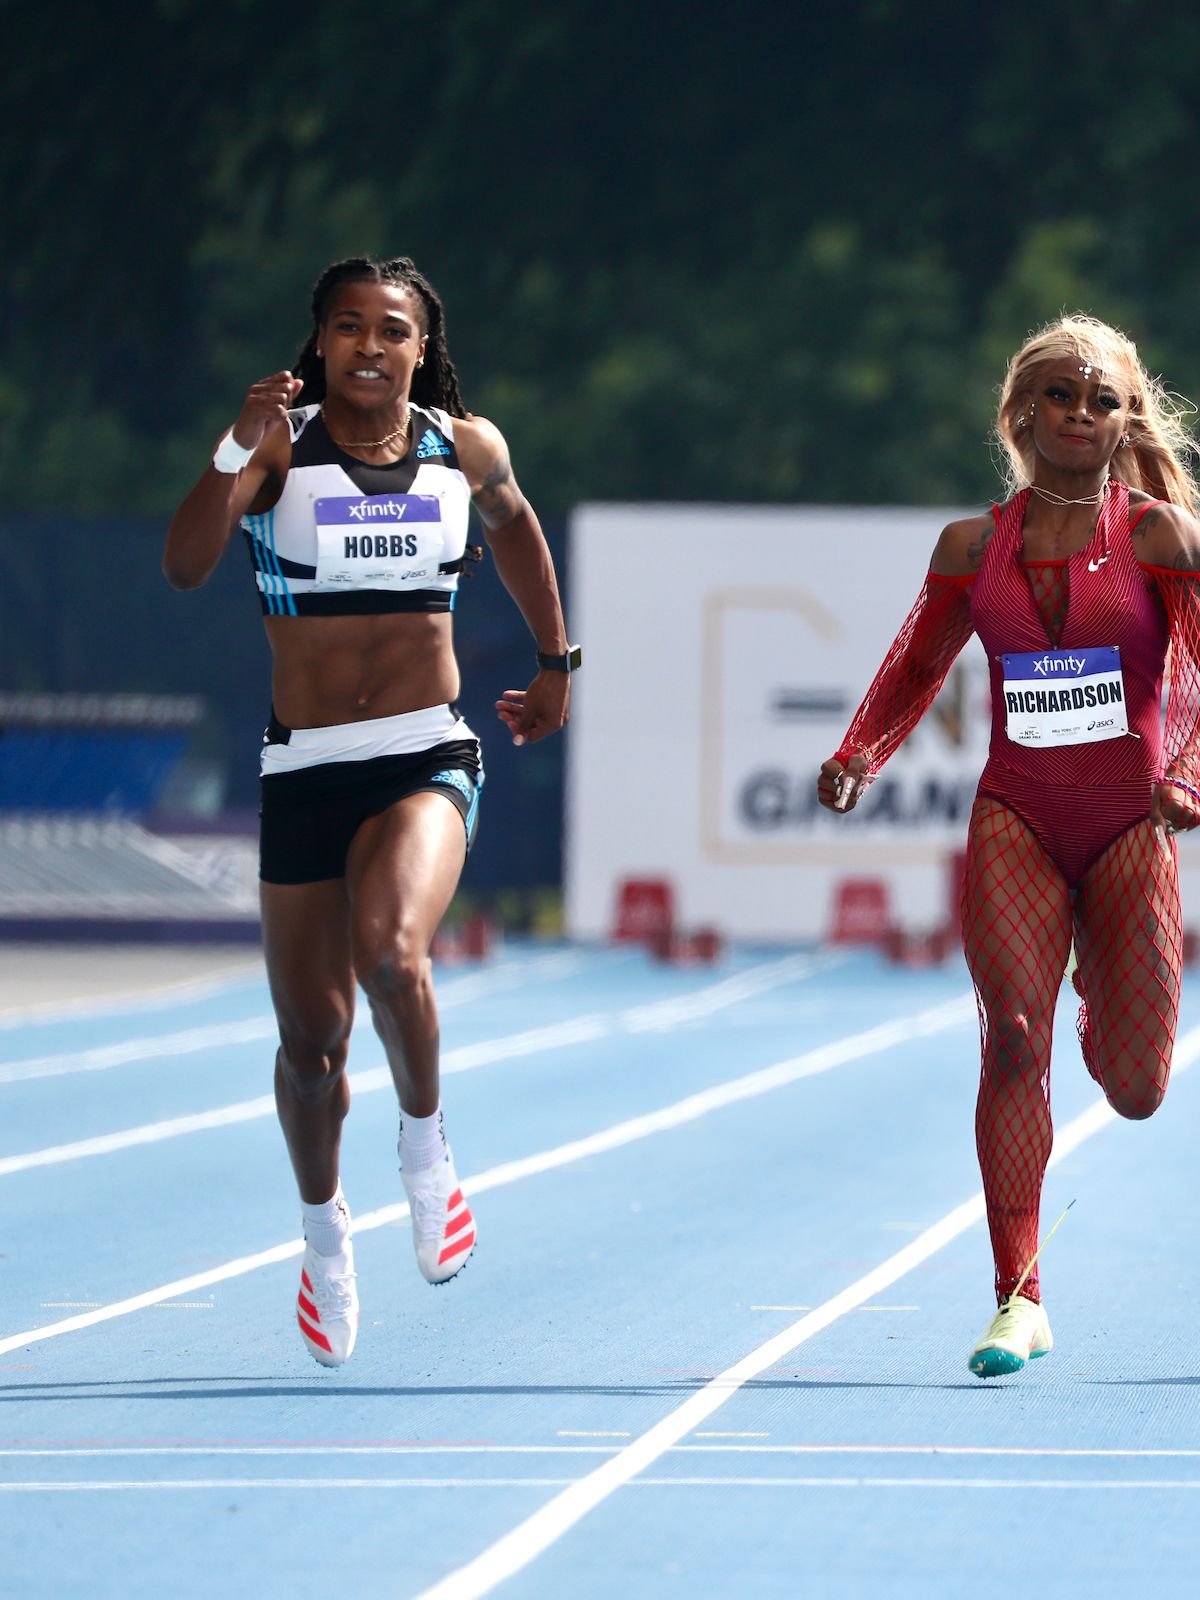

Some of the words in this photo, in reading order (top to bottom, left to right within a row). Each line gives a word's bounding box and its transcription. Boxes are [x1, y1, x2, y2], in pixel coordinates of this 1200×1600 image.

[416, 446, 449, 458] adidas
[349, 501, 407, 520] xfinity
[344, 534, 417, 558] HOBBS
[1033, 656, 1086, 676] xfinity
[1006, 681, 1122, 713] RICHARDSON
[1096, 719, 1114, 729] asics
